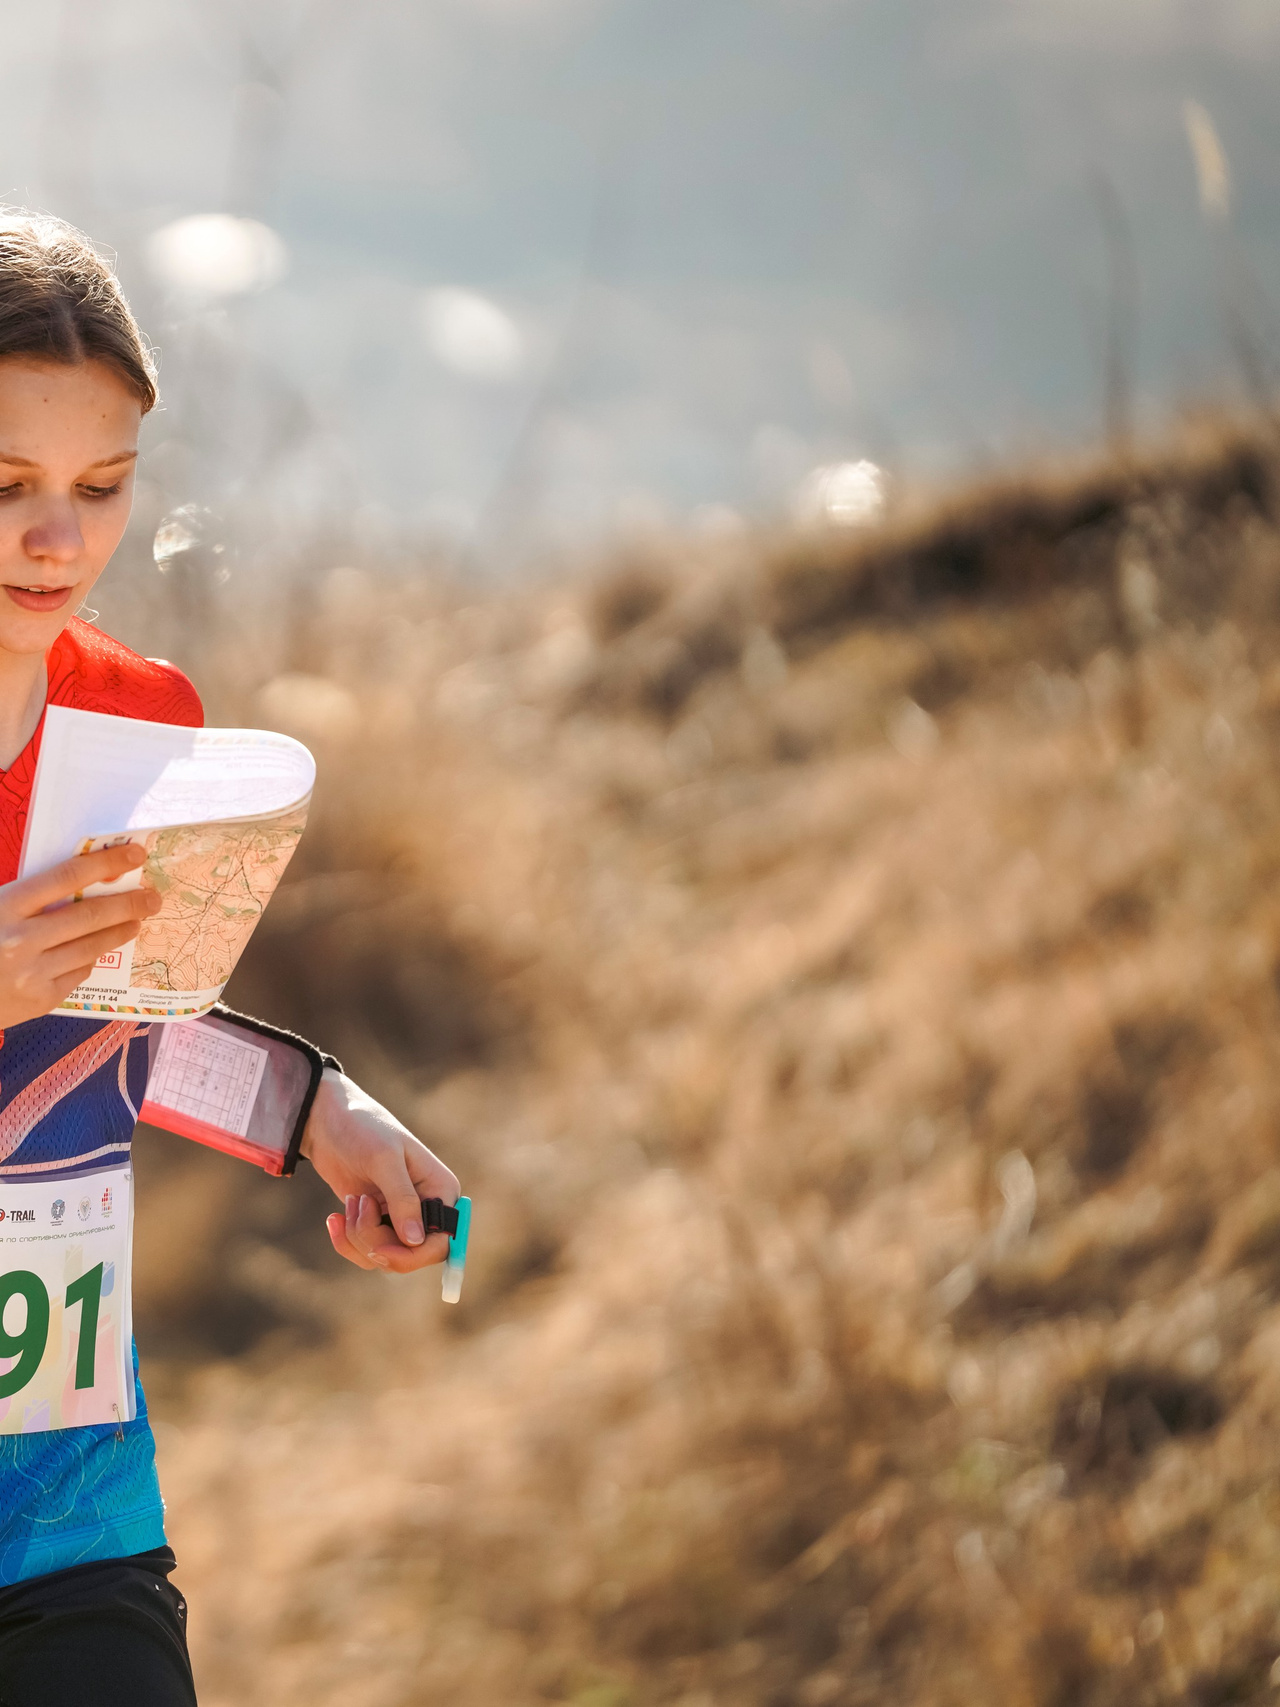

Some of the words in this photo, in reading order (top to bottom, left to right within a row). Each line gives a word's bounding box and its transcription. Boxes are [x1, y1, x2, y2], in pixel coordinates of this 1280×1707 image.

[76, 986, 128, 994] рганизатора
[19, 1233, 67, 1242] СПОРТИВНОМУ
[68, 1224, 116, 1237] ОРИЕНТИРОВАНИЮ
